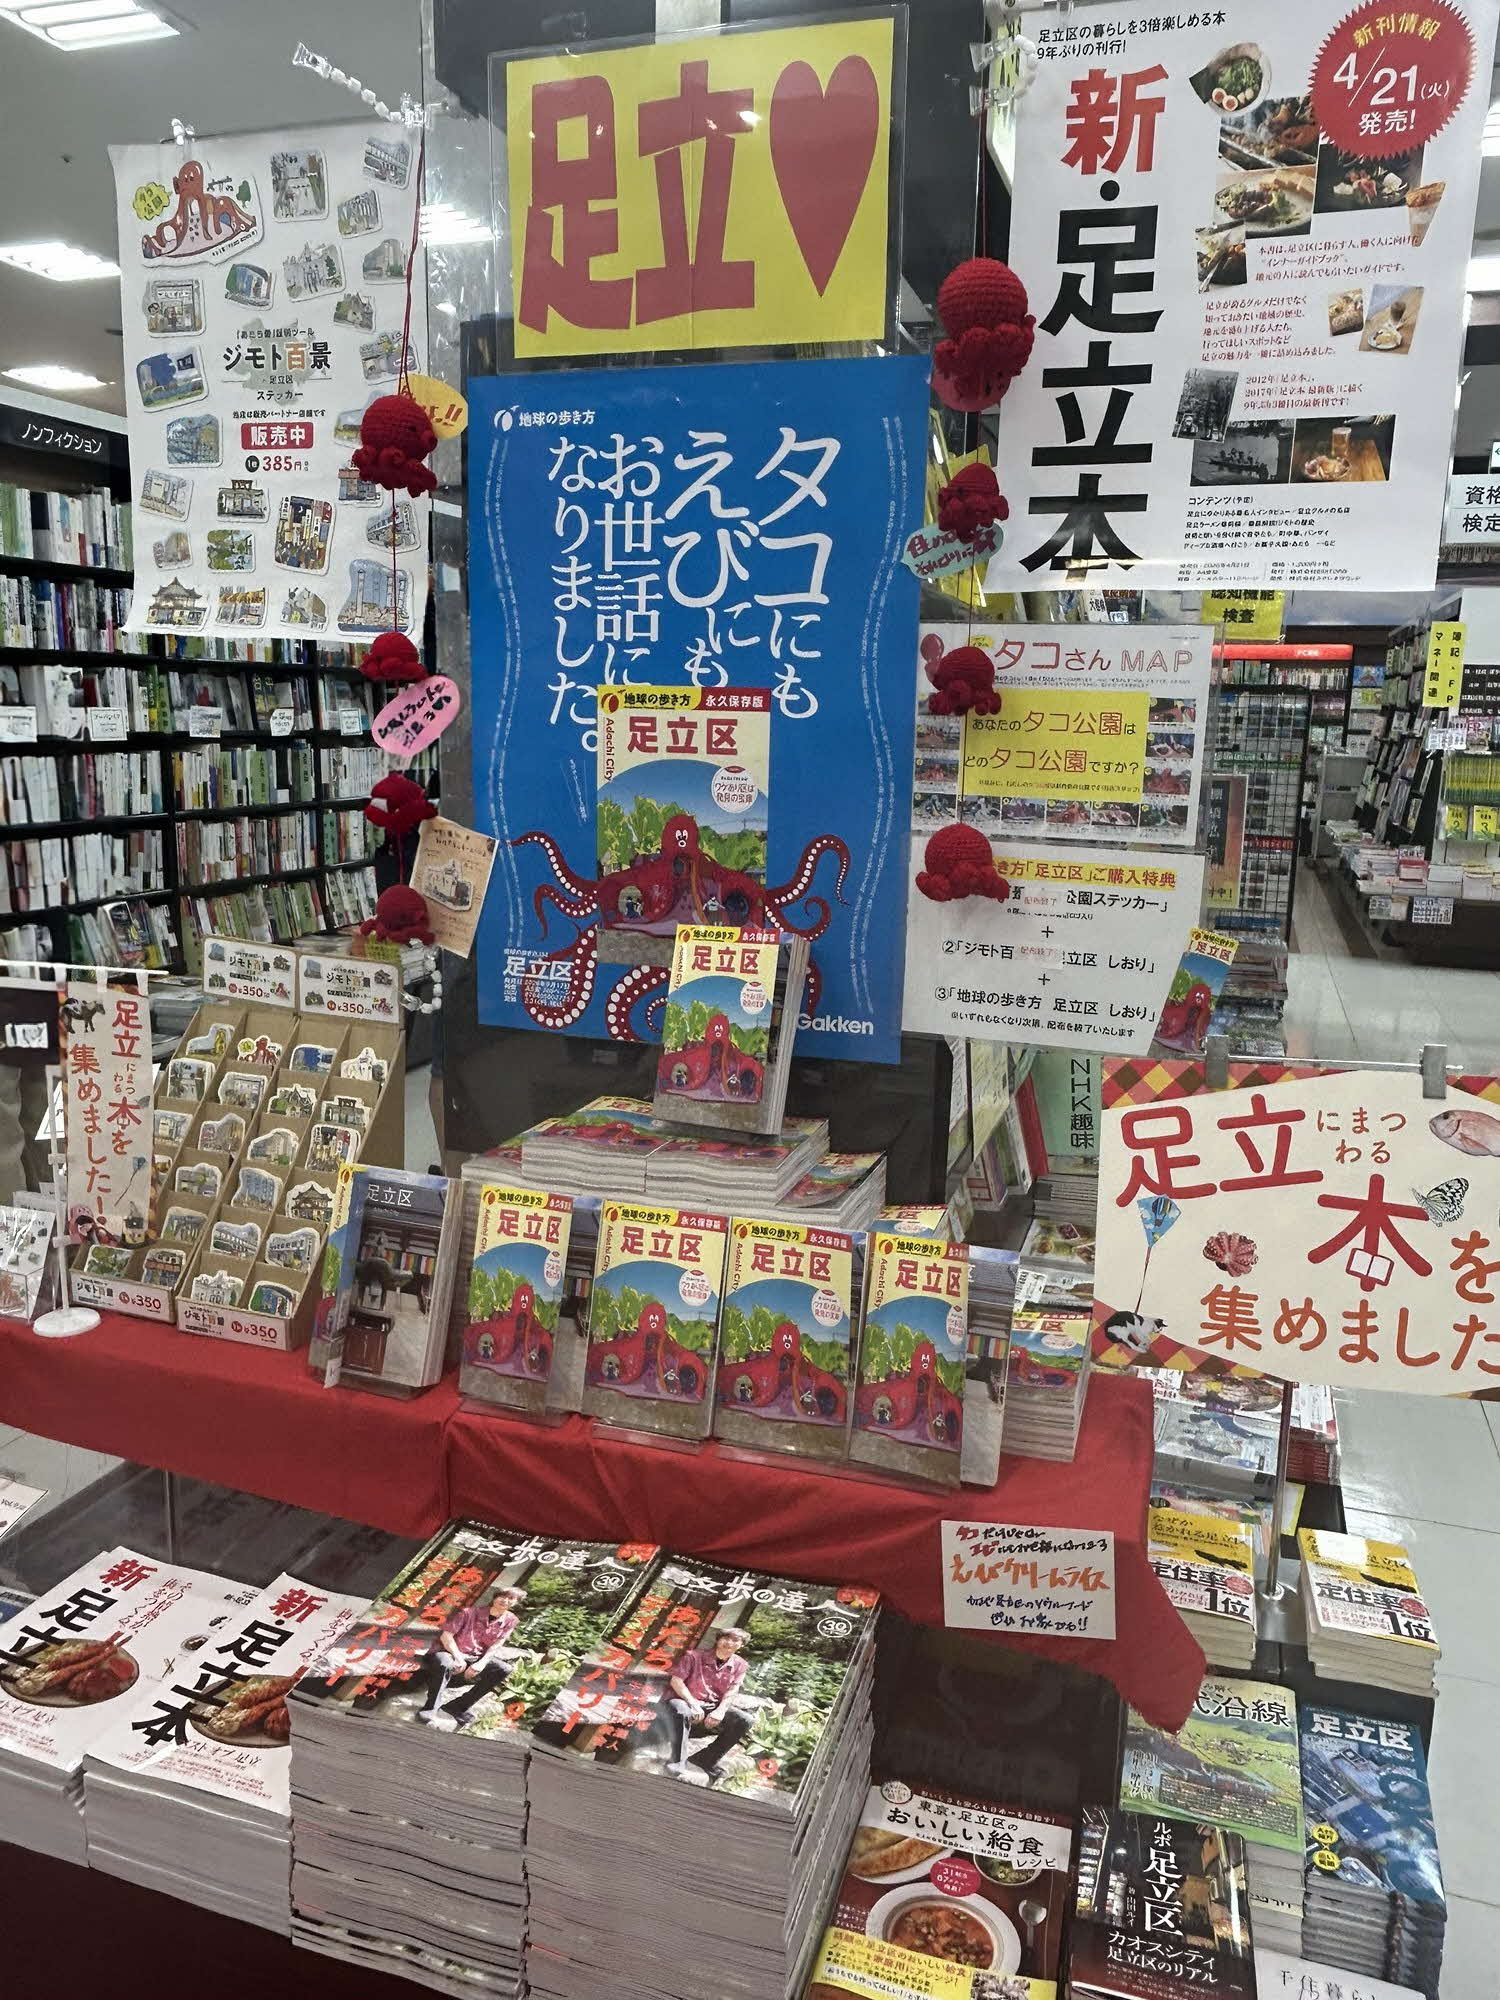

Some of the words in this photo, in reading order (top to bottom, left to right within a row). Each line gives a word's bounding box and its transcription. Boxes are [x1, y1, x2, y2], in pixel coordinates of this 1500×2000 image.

[1038, 10, 1226, 43] 足立区の暮らしを3倍楽しめる本
[1353, 12, 1441, 48] 新刊情報
[1036, 39, 1126, 60] 9年ぶりの刊行!
[1358, 108, 1416, 137] 発売!
[519, 60, 755, 334] 足立
[223, 342, 332, 371] ジモト百景
[256, 391, 304, 401] ステッカー
[519, 410, 596, 427] 地球の歩き方
[22, 424, 102, 454] ノンフィクション
[251, 426, 306, 446] 販売中
[594, 433, 665, 686] お世話に
[663, 430, 760, 688] えびにも
[754, 427, 841, 719] タコにも
[548, 437, 599, 752] なりました。
[1223, 608, 1255, 624] 検査
[994, 638, 1112, 671] タコさん
[1120, 648, 1193, 672] MAP
[624, 693, 691, 706] 地球の歩き方
[705, 695, 764, 708] 永久保存版
[627, 716, 738, 756] 足立区
[971, 711, 1137, 736] あなたのタコ公園は
[963, 747, 1140, 774] どのタコ公園ですか?
[503, 955, 575, 981] 足立区
[691, 944, 761, 975] 足立区
[1053, 998, 1099, 1015] 足立区
[112, 1000, 142, 1058] 足立
[798, 1012, 874, 1035] Gakken
[69, 1043, 112, 1226] 集めました!
[106, 1096, 143, 1155] 本を
[1316, 1106, 1406, 1134] にまつ
[1115, 1094, 1323, 1208] 足立
[1334, 1139, 1391, 1164] わる
[366, 1183, 414, 1207] 足立区
[497, 1208, 562, 1244] 足立区
[621, 1207, 671, 1224] 地球の歩き方
[620, 1225, 703, 1263] 足立区
[750, 1224, 800, 1241] 地球の歩き方
[896, 1240, 942, 1255] 地球の歩き方
[751, 1242, 832, 1283] 足立区
[895, 1258, 963, 1298] 足立区
[1198, 1284, 1500, 1375] 集めました
[1204, 1587, 1252, 1622] 1位
[1315, 1581, 1404, 1613] 定住率
[0, 1559, 157, 1683] 新・足立
[1382, 1609, 1440, 1645] 1位
[1310, 1712, 1414, 1752] 足立区
[917, 1799, 1019, 1832] 東京・足立区の
[886, 1807, 1044, 1858] おいしい給食
[1153, 1822, 1173, 1848] ルポ
[1015, 1857, 1057, 1869] レシピ
[1143, 1847, 1184, 1937] 足立区
[1107, 1945, 1219, 1984] 足立区のリアル
[1108, 1930, 1216, 1970] カオスシティ
